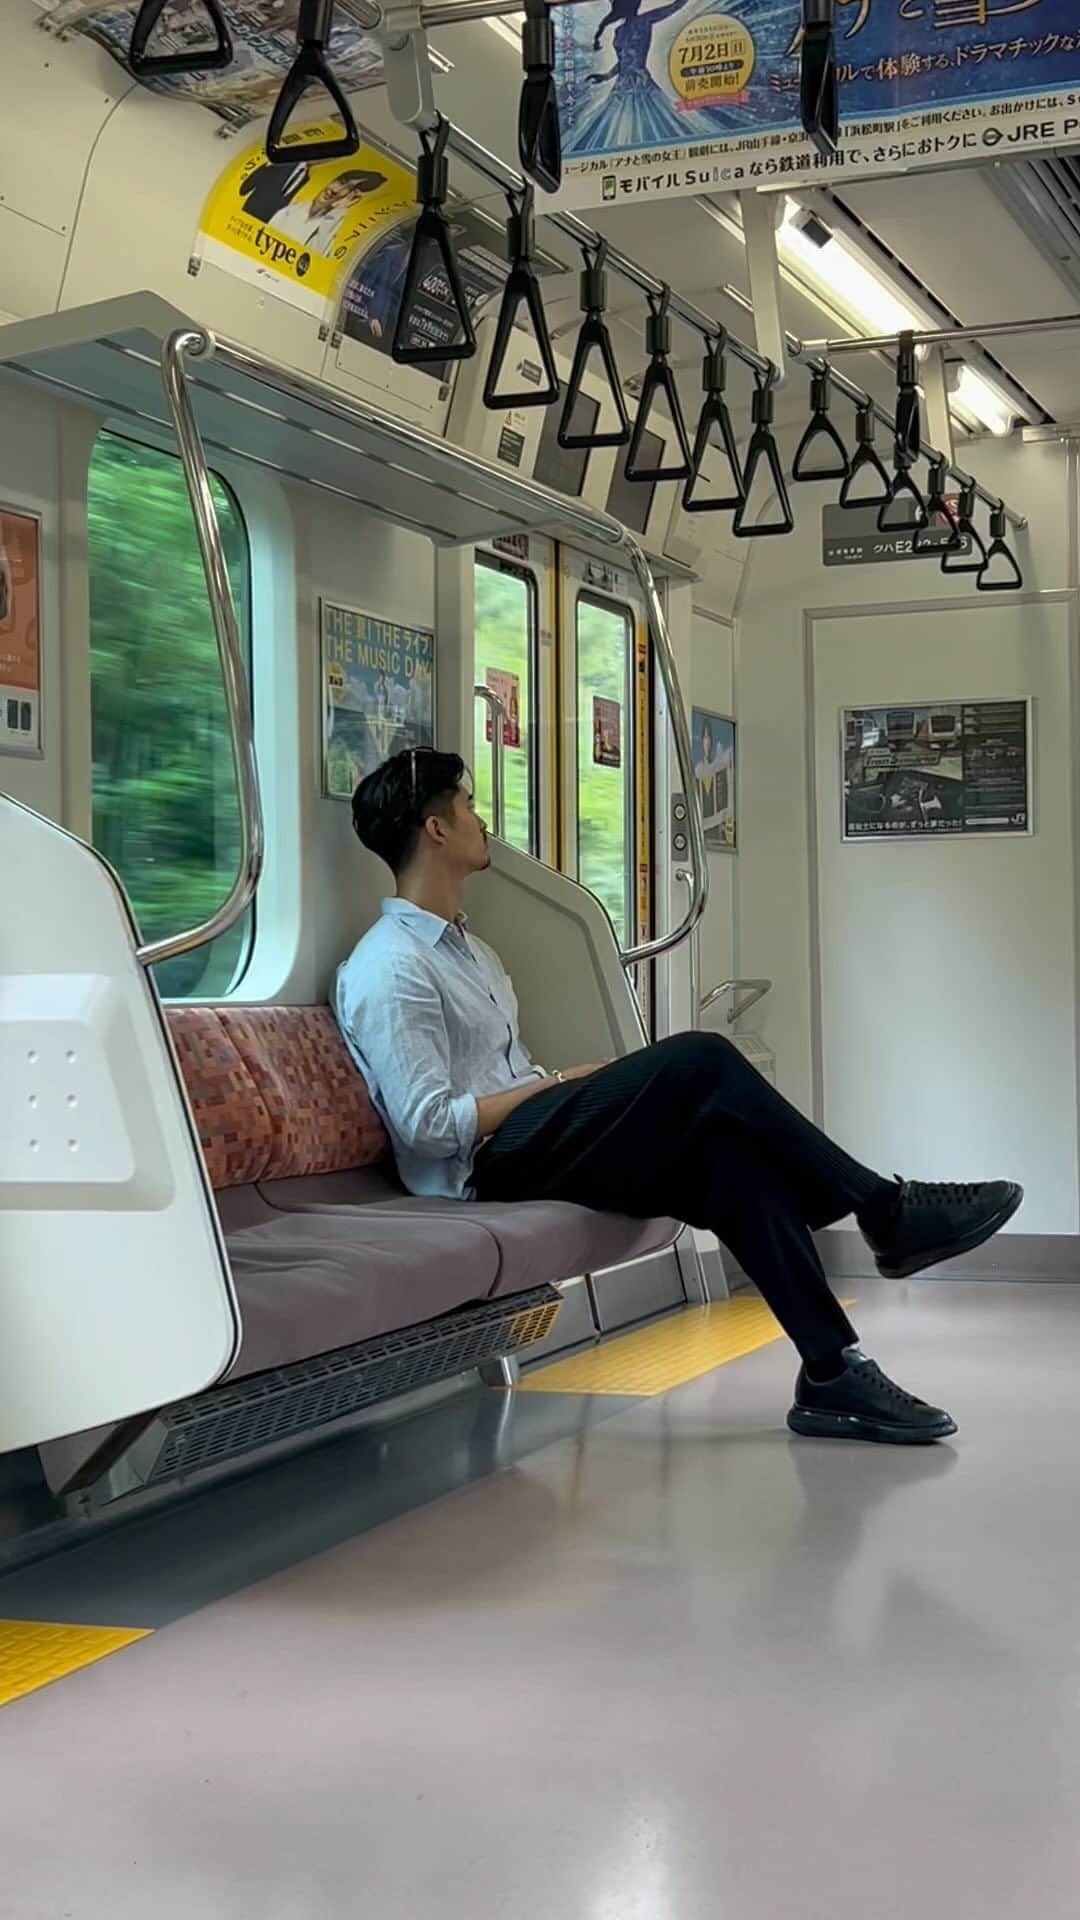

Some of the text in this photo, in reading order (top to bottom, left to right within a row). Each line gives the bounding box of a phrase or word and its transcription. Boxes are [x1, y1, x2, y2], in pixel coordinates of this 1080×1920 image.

[620, 173, 680, 193] モバイル
[685, 167, 744, 185] Suica
[1008, 121, 1055, 142] JRE
[1064, 119, 1080, 135] P
[255, 226, 296, 264] type
[373, 621, 400, 649] THE
[327, 635, 432, 683] THE MUSIC DAY
